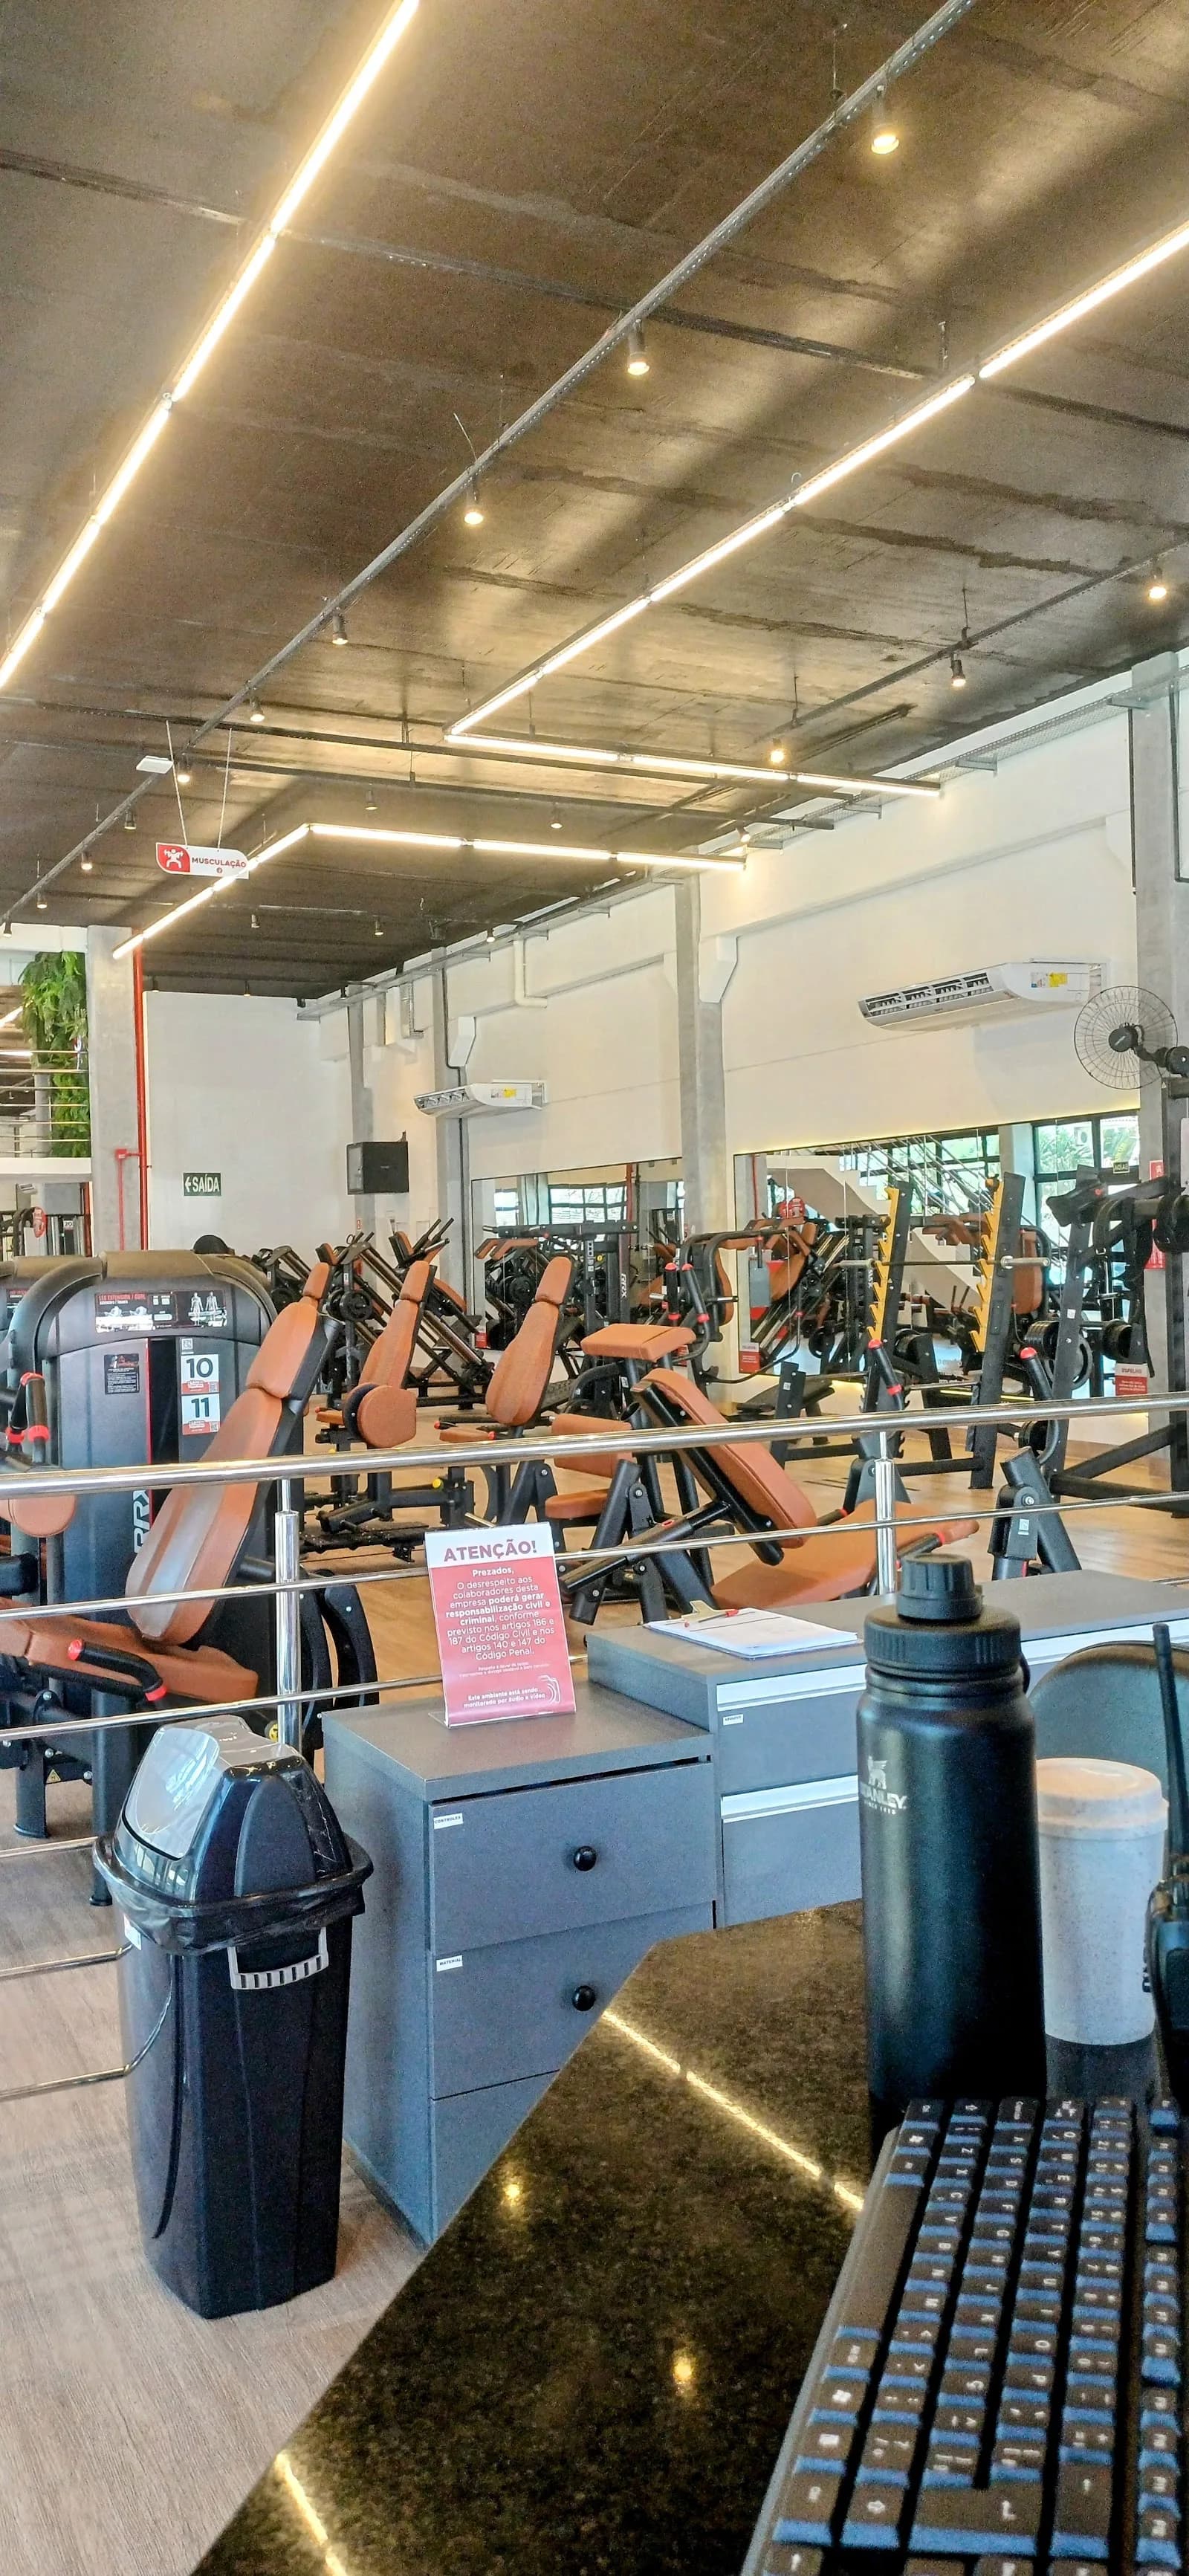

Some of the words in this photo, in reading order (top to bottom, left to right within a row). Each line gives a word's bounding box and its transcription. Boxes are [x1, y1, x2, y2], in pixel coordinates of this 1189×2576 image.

[192, 857, 247, 869] MUSCULAÇÃO
[192, 1174, 220, 1192] SAÍDA
[186, 1357, 213, 1378] 10
[191, 1397, 210, 1418] 11
[444, 1538, 537, 1562] ATENÇÃO!
[472, 1566, 514, 1577] Prezados,
[453, 1587, 513, 1599] colaboradores
[516, 1584, 539, 1592] desta
[457, 1582, 464, 1590] O
[467, 1577, 516, 1589] desrespeito
[446, 1602, 523, 1618] responsabilização
[525, 1600, 543, 1609] civil
[450, 1599, 486, 1609] empresa
[488, 1593, 519, 1605] poderá
[522, 1593, 545, 1602] gerar
[460, 1615, 497, 1625] criminal,
[499, 1611, 540, 1622] conforme
[447, 1625, 482, 1637] previsto
[484, 1624, 499, 1632] nos
[502, 1620, 531, 1631] artigos
[532, 1618, 547, 1626] 186
[449, 1637, 463, 1645] 187
[465, 1635, 477, 1643] do
[479, 1631, 510, 1642] Código
[512, 1629, 531, 1638] Civil
[461, 1643, 491, 1654] artigos
[493, 1641, 508, 1649] 140
[518, 1637, 532, 1646] 147
[534, 1637, 545, 1645] do
[476, 1650, 507, 1661] Código
[509, 1648, 535, 1657] Penal.
